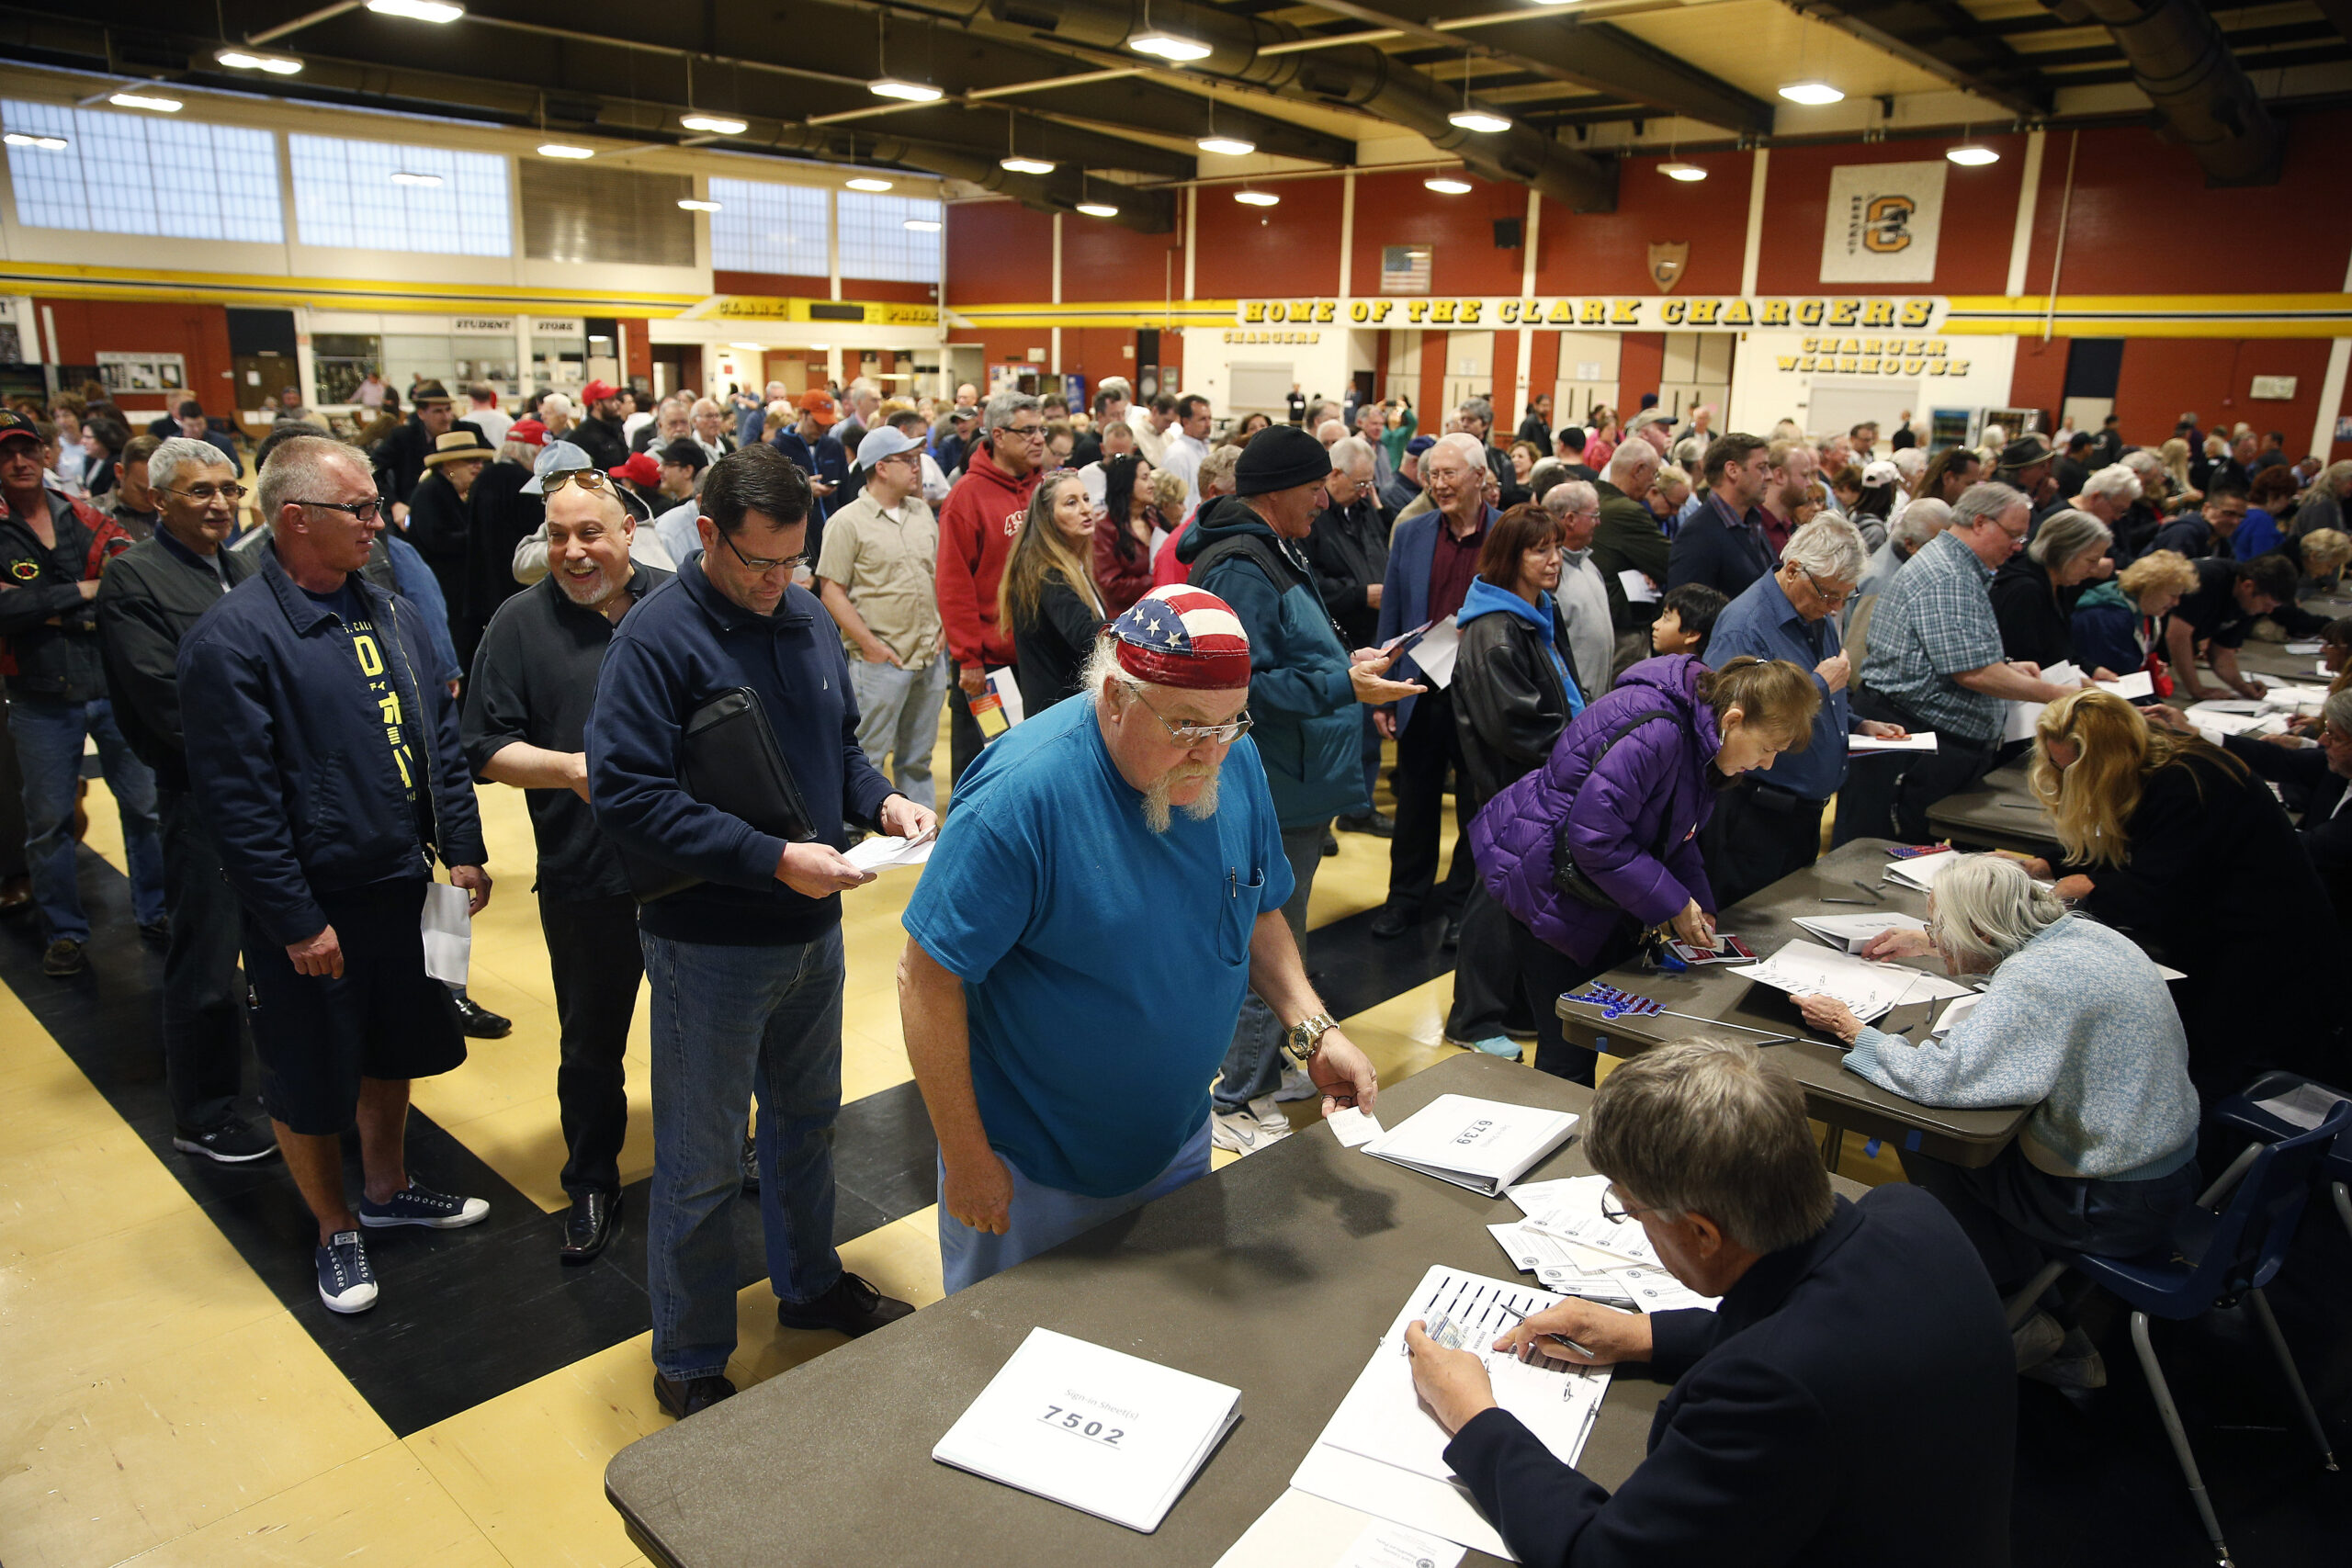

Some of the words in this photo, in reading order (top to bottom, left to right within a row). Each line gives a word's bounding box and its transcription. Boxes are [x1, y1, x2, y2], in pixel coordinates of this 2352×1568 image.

[457, 319, 511, 331] STUDENT
[538, 321, 573, 331] STORE
[1245, 300, 1336, 322] HOME
[1351, 301, 1393, 322] OF
[1408, 300, 1482, 323] THE
[1498, 299, 1641, 324] CLARK
[1660, 299, 1934, 327] CHARGERS
[1223, 332, 1320, 344] CHARGERS
[1802, 337, 1948, 357] CHARGER
[1776, 355, 1969, 377] WEARHOUSE
[1003, 510, 1028, 536] 49
[1456, 1120, 1493, 1145] 6739
[1064, 1388, 1098, 1405] Sign-in
[1099, 1402, 1139, 1421] Sheet(s)
[1043, 1404, 1125, 1444] 7502
